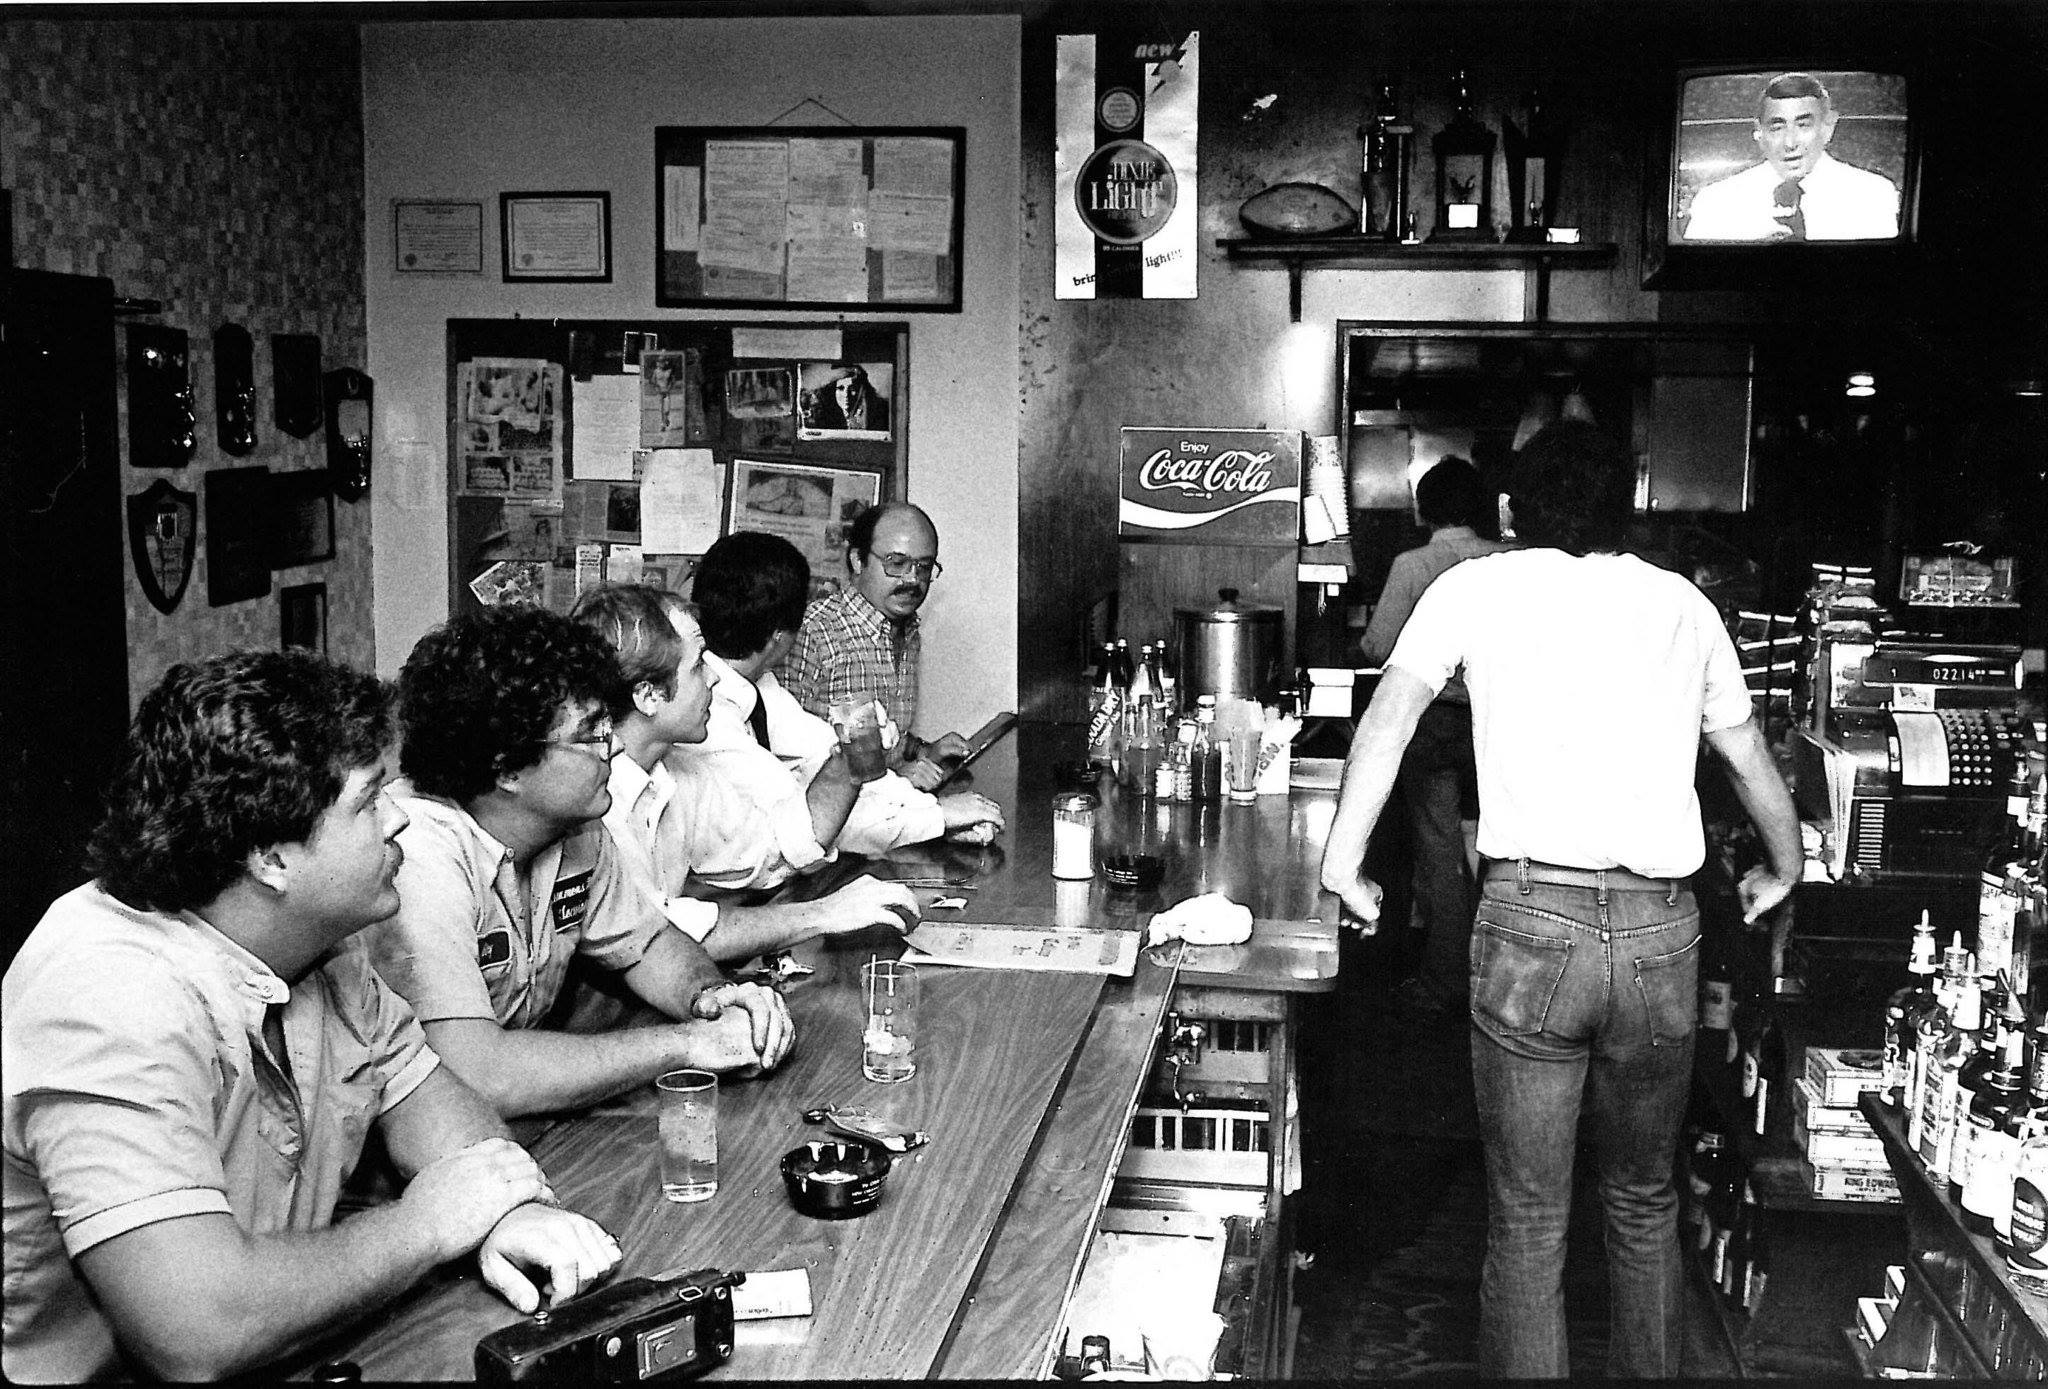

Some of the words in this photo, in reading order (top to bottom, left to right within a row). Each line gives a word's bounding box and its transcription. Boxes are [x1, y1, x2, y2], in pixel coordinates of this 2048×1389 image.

[1134, 43, 1175, 59] new
[1073, 274, 1095, 286] brin
[1180, 441, 1209, 454] Enjoy
[1140, 449, 1276, 492] Coca-Cola
